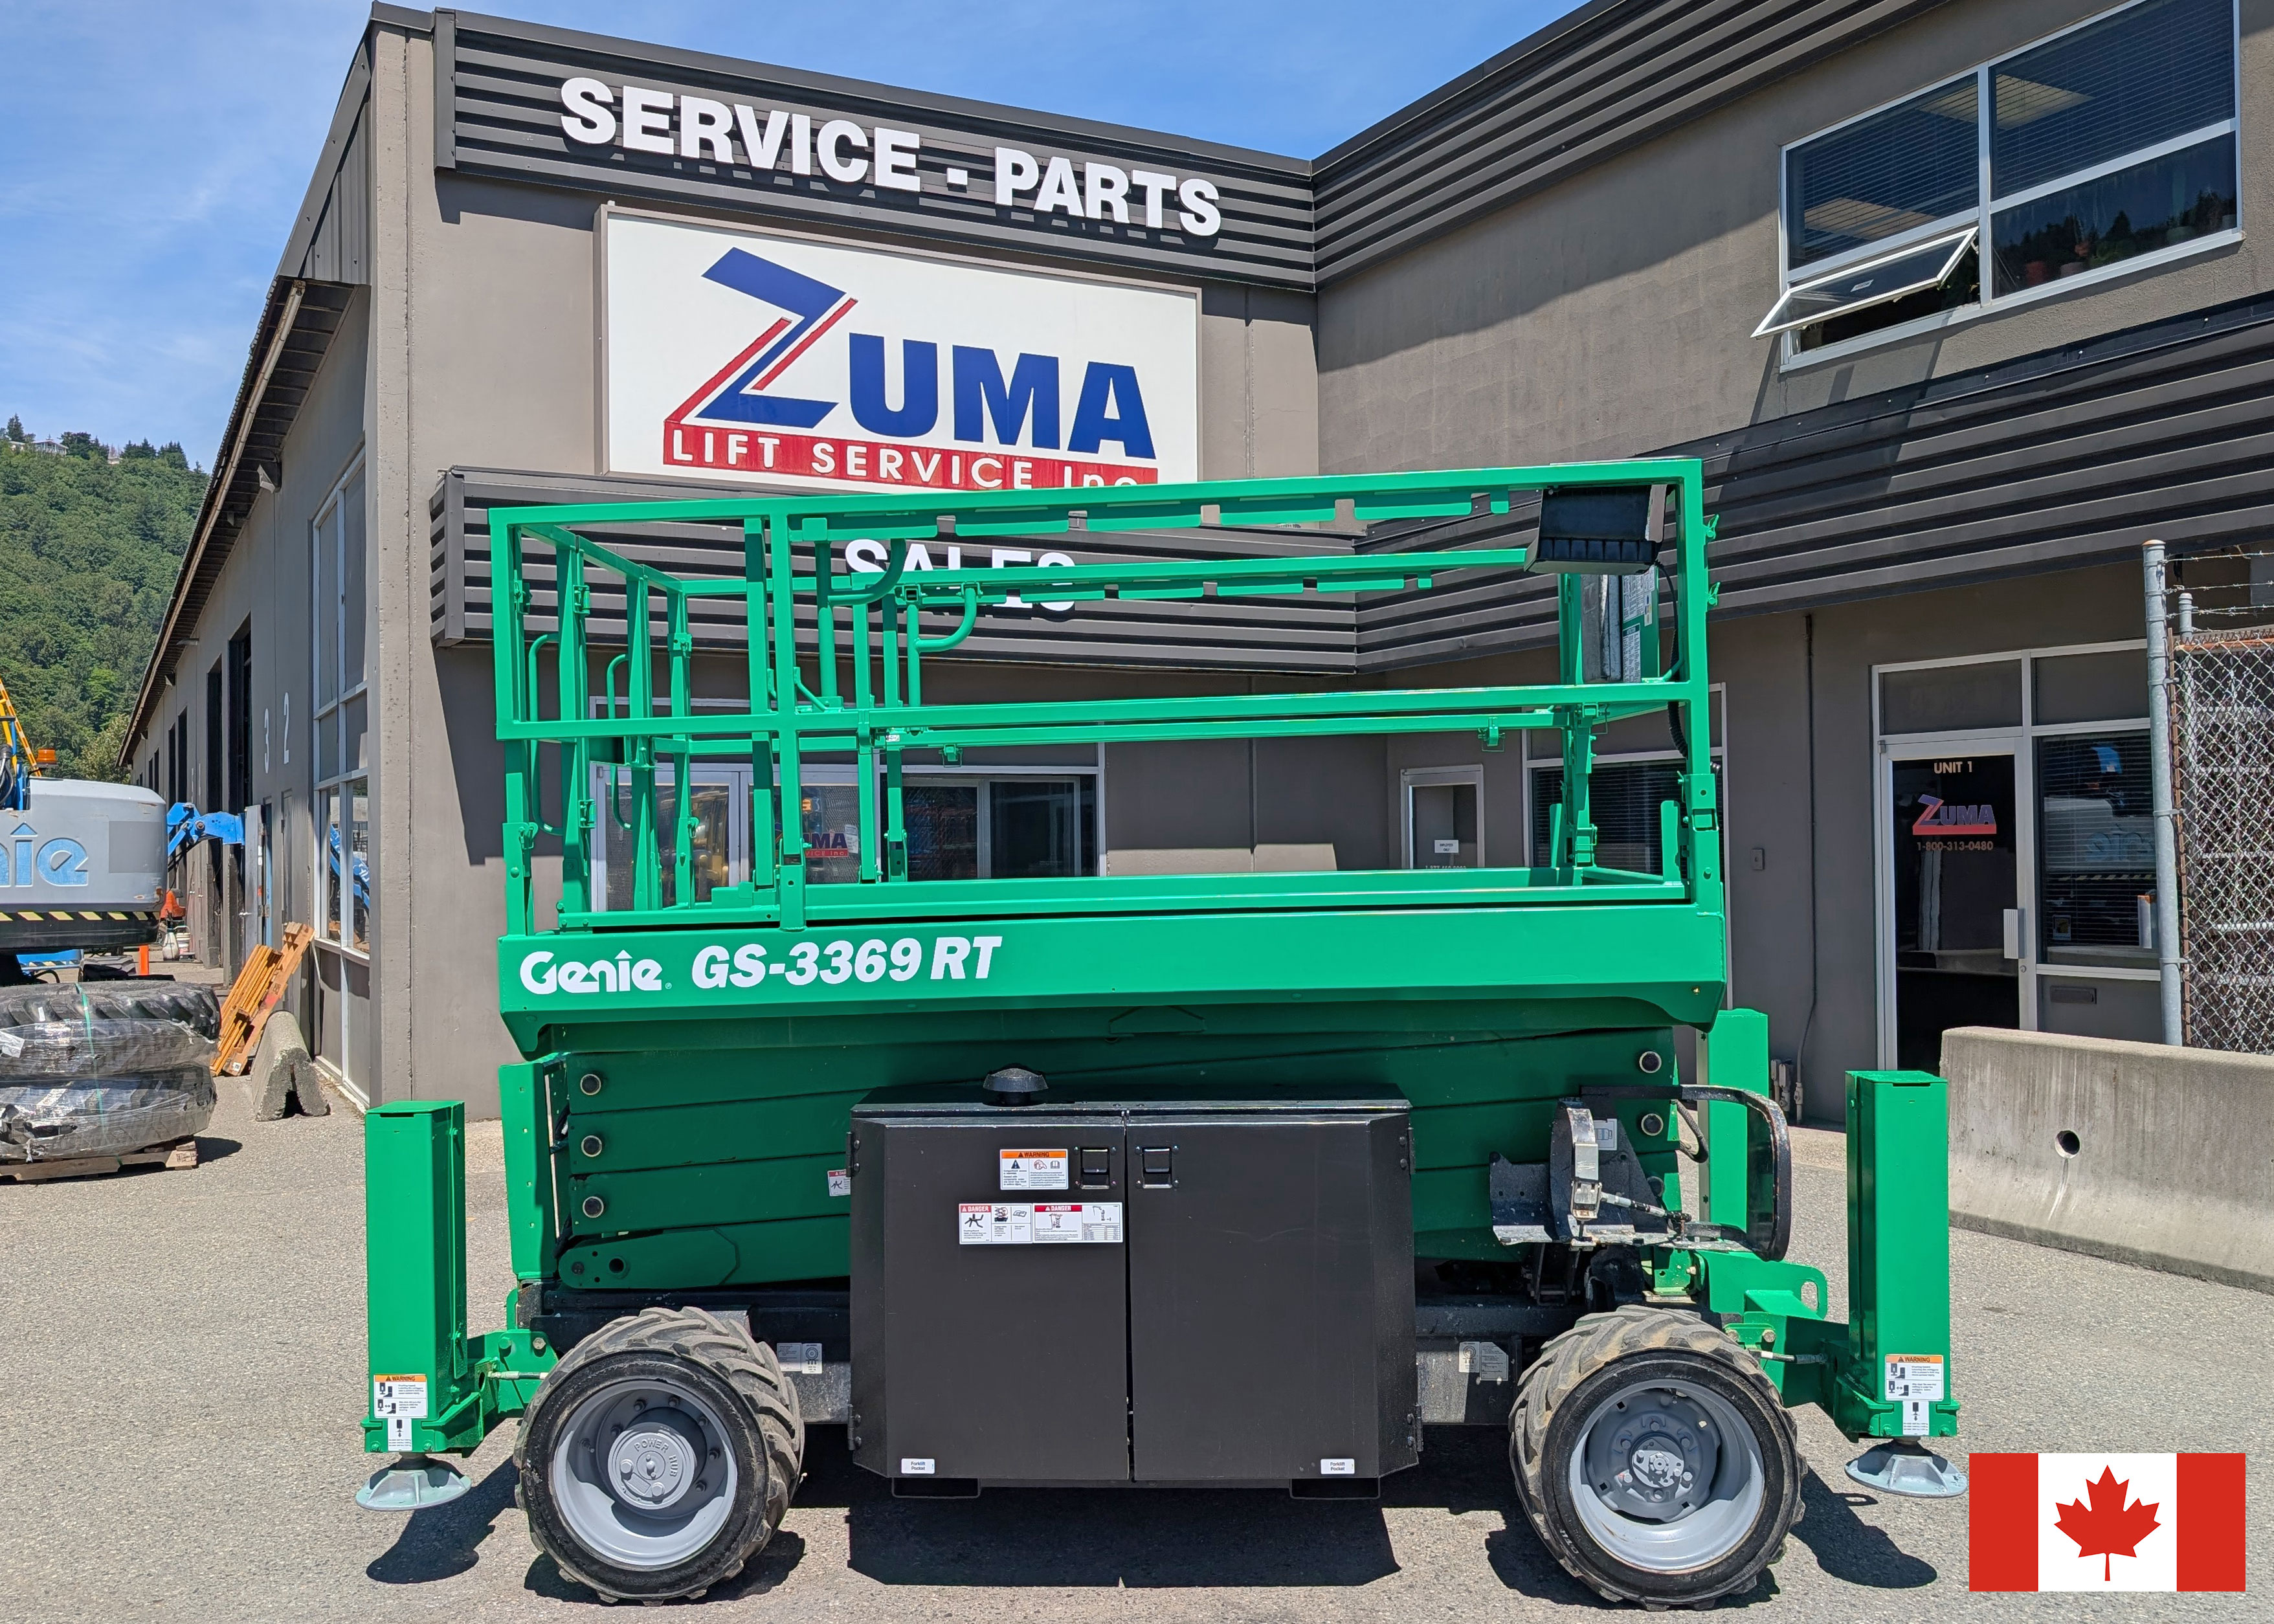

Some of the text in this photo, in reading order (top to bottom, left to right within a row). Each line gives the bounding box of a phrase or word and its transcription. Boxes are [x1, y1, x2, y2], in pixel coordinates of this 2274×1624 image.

[560, 77, 920, 192] SERVICE
[994, 146, 1221, 236] PARTS
[665, 247, 1155, 459] ZUMA
[673, 429, 781, 468] LIFT
[812, 443, 1032, 489] SERVICE
[264, 707, 269, 774] 3
[284, 692, 289, 764] 2
[1934, 761, 1972, 774] UNIT 1
[1913, 794, 1996, 826] ZUMA
[1917, 841, 1994, 851] 1-800-313-0480
[520, 950, 662, 994] Genie
[692, 936, 1002, 989] GS-3369 RT
[634, 1438, 678, 1476] POWER HUB
